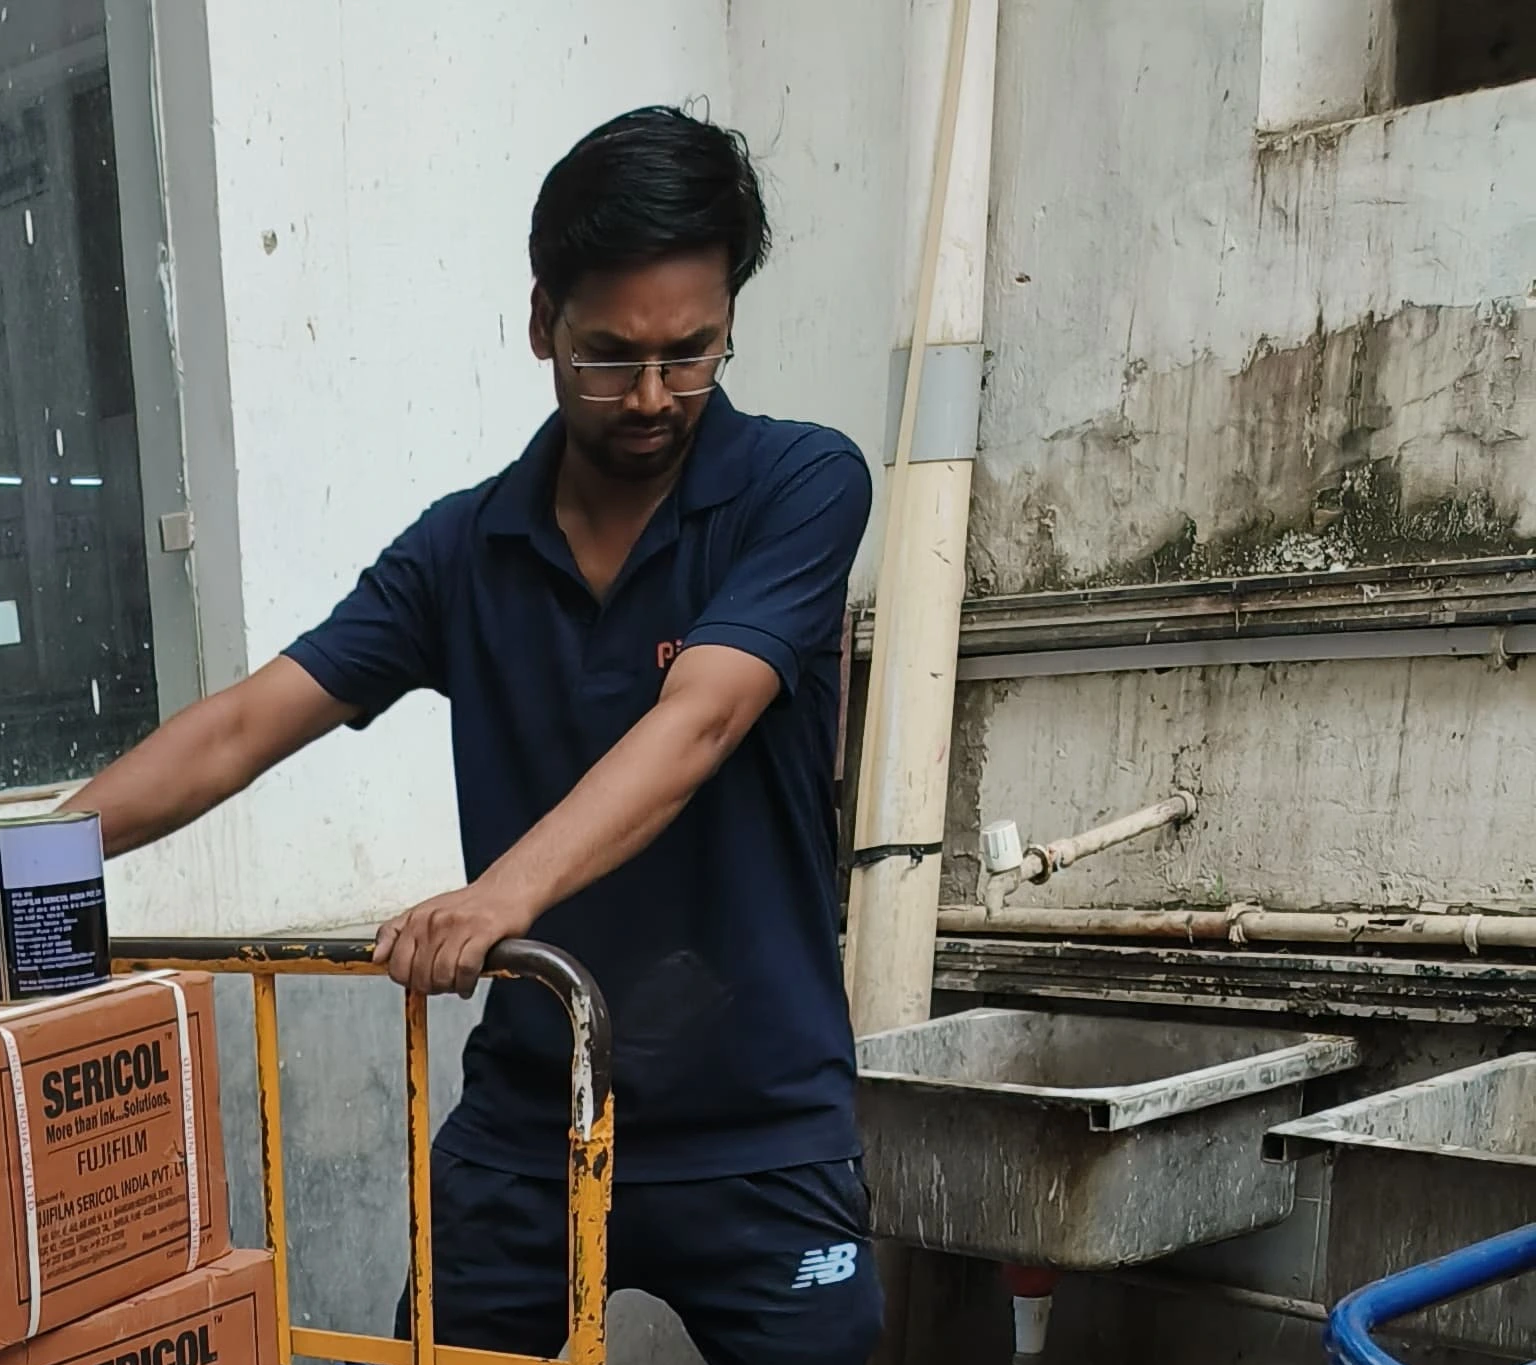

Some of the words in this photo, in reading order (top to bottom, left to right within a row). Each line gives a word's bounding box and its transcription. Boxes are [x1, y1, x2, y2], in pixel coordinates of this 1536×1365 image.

[42, 1039, 170, 1120] SERICOL
[45, 1124, 74, 1145] More
[74, 1113, 99, 1135] than
[76, 1127, 148, 1176] FUJIFILM
[77, 1184, 117, 1215] SERICOL
[120, 1172, 151, 1198] INDIA
